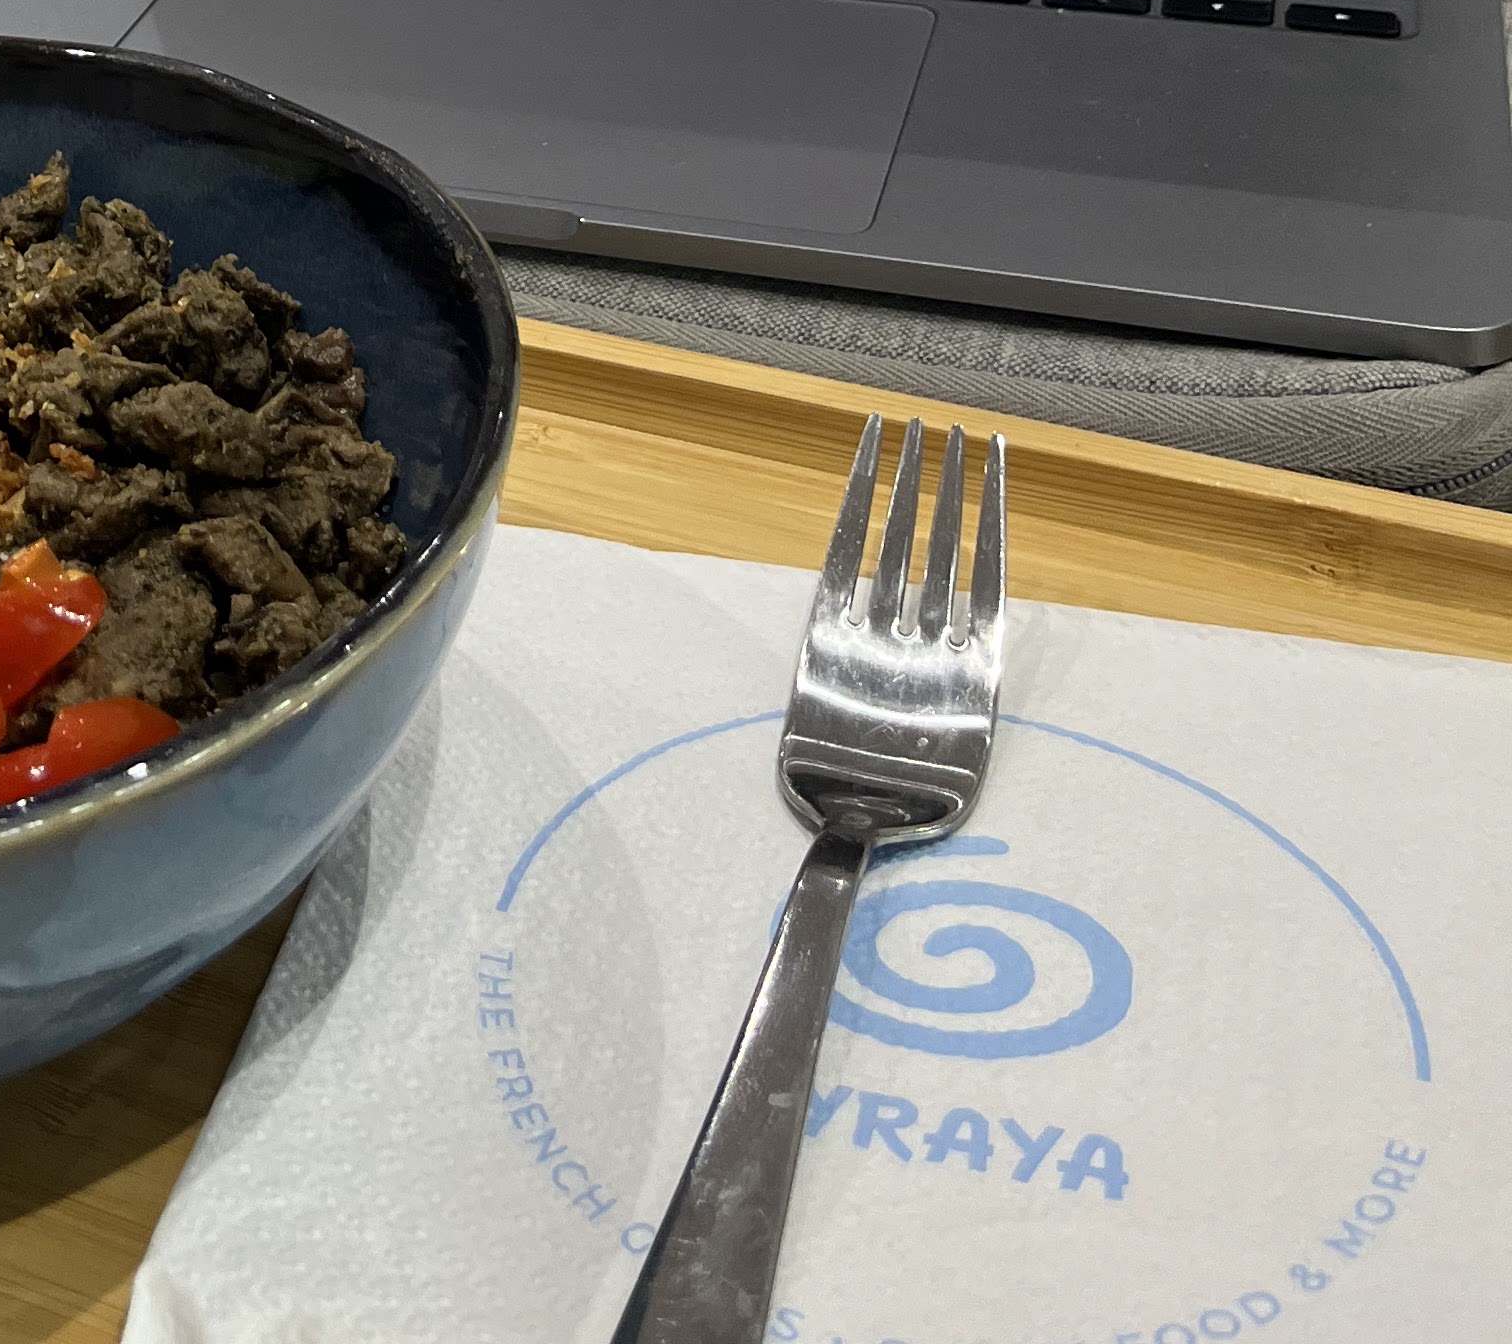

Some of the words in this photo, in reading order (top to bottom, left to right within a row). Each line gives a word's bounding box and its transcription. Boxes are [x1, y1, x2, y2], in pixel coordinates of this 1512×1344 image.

[478, 951, 515, 1029] THE
[488, 1048, 617, 1222] FRENCH
[1289, 1263, 1330, 1293] &
[1321, 1137, 1429, 1259] MORE
